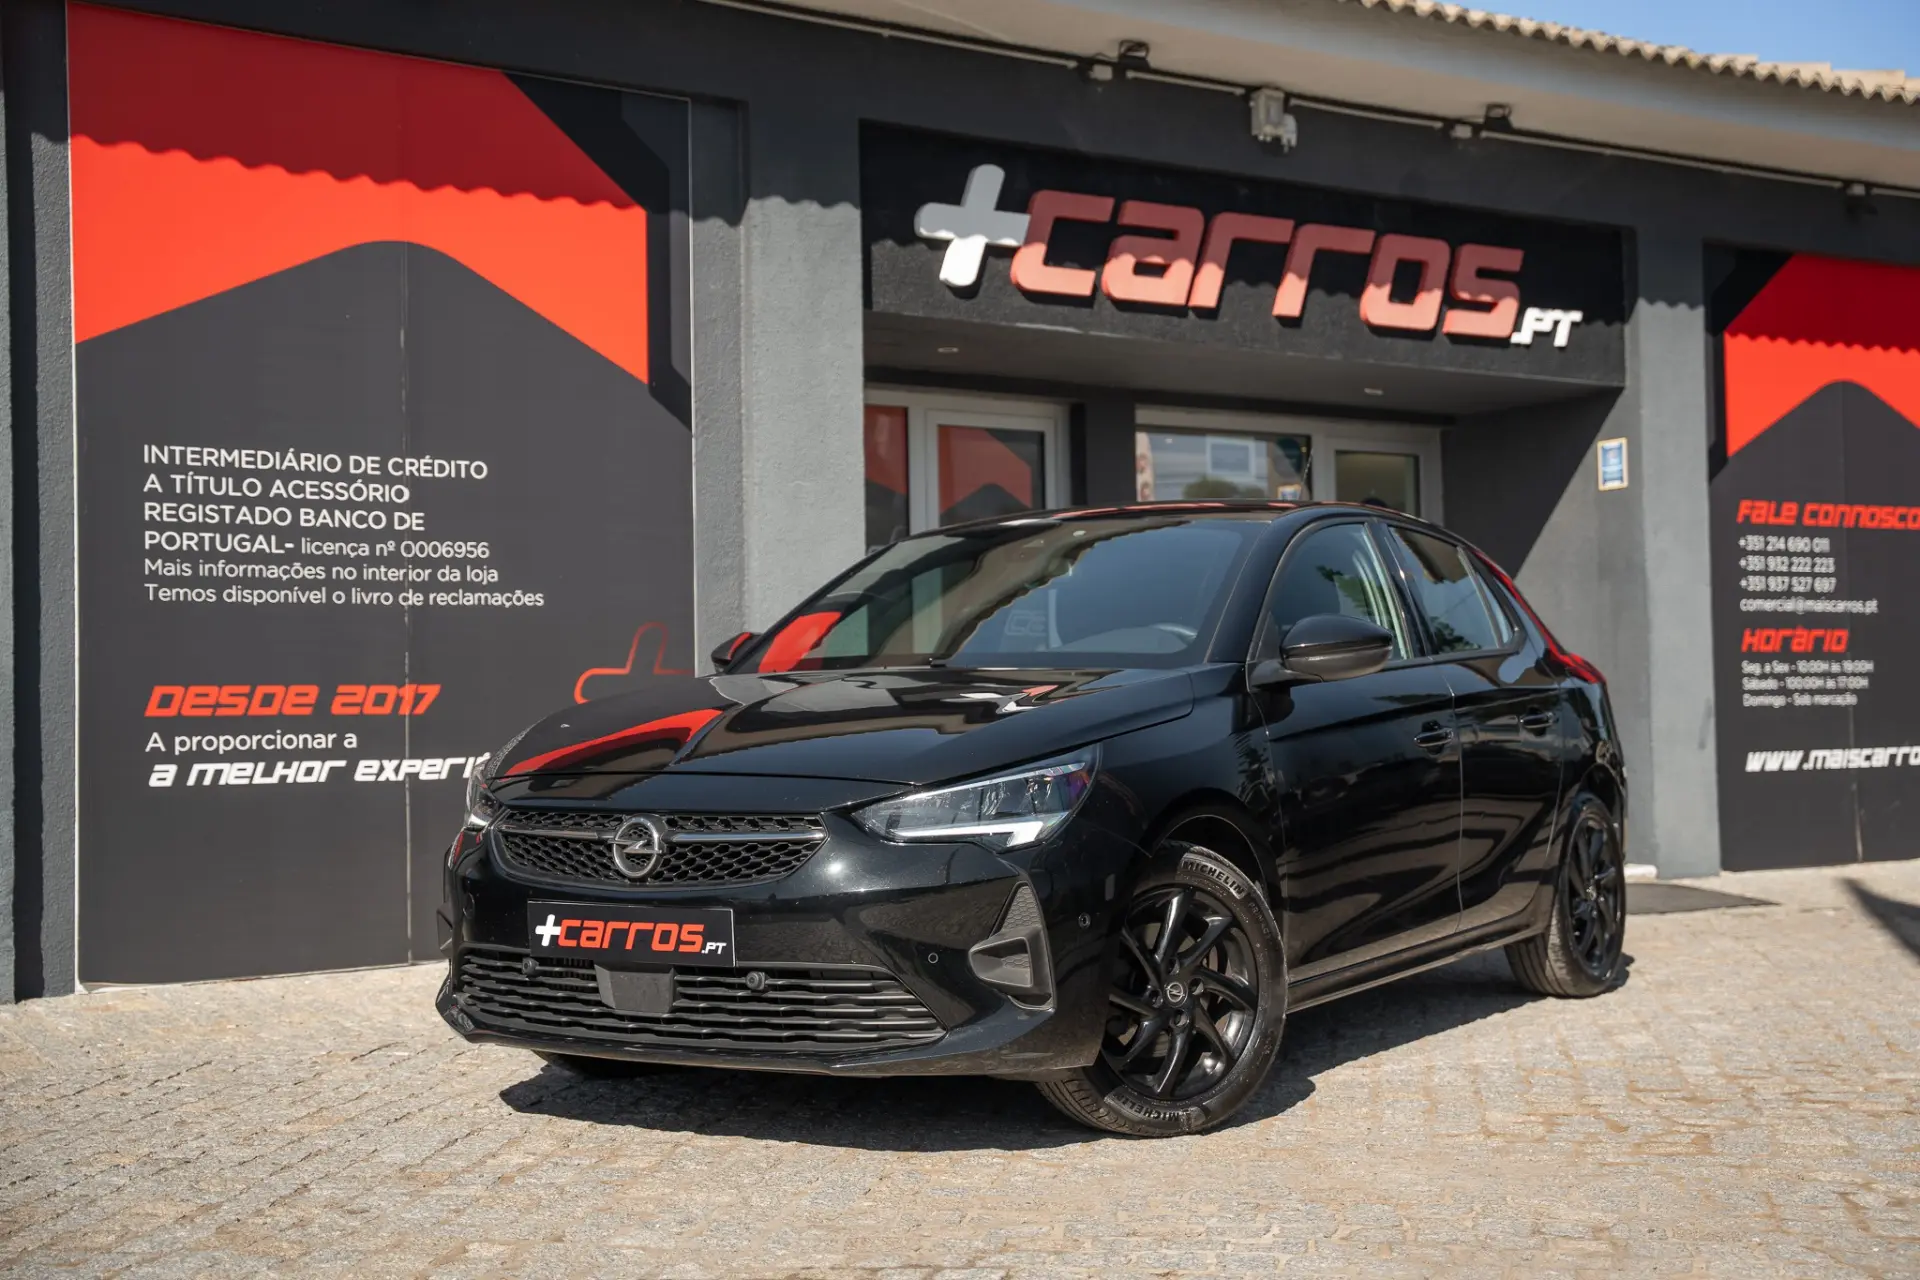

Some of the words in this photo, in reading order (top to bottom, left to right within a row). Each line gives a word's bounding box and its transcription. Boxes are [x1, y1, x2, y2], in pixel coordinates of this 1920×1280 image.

[144, 445, 342, 474] INTERMEDIÁRIO
[350, 456, 381, 475] DE
[388, 455, 487, 479] CRÉDITO
[144, 474, 162, 492] A
[170, 472, 262, 497] TÍTULO
[269, 479, 409, 503] ACESSÓRIO
[145, 502, 292, 526] REGISTADO
[300, 508, 386, 529] BANCO
[394, 512, 425, 530] DE
[302, 537, 369, 558] licença
[376, 540, 395, 556] nº
[401, 541, 489, 558] 0006956
[145, 559, 192, 576] Mais
[200, 560, 326, 581] informações
[332, 567, 357, 580] no
[364, 564, 432, 581] interior
[437, 565, 460, 582] da
[467, 565, 498, 585] loja
[144, 584, 216, 602] Temos
[223, 585, 326, 605] disponível
[332, 591, 345, 604] o
[352, 588, 393, 605] livro
[399, 589, 424, 606] de
[429, 590, 544, 608] reclamações
[331, 684, 441, 716] 2017
[145, 732, 165, 752] A
[175, 730, 337, 755] proporcionar
[344, 734, 357, 748] a
[1182, 859, 1245, 895] MICHELIN
